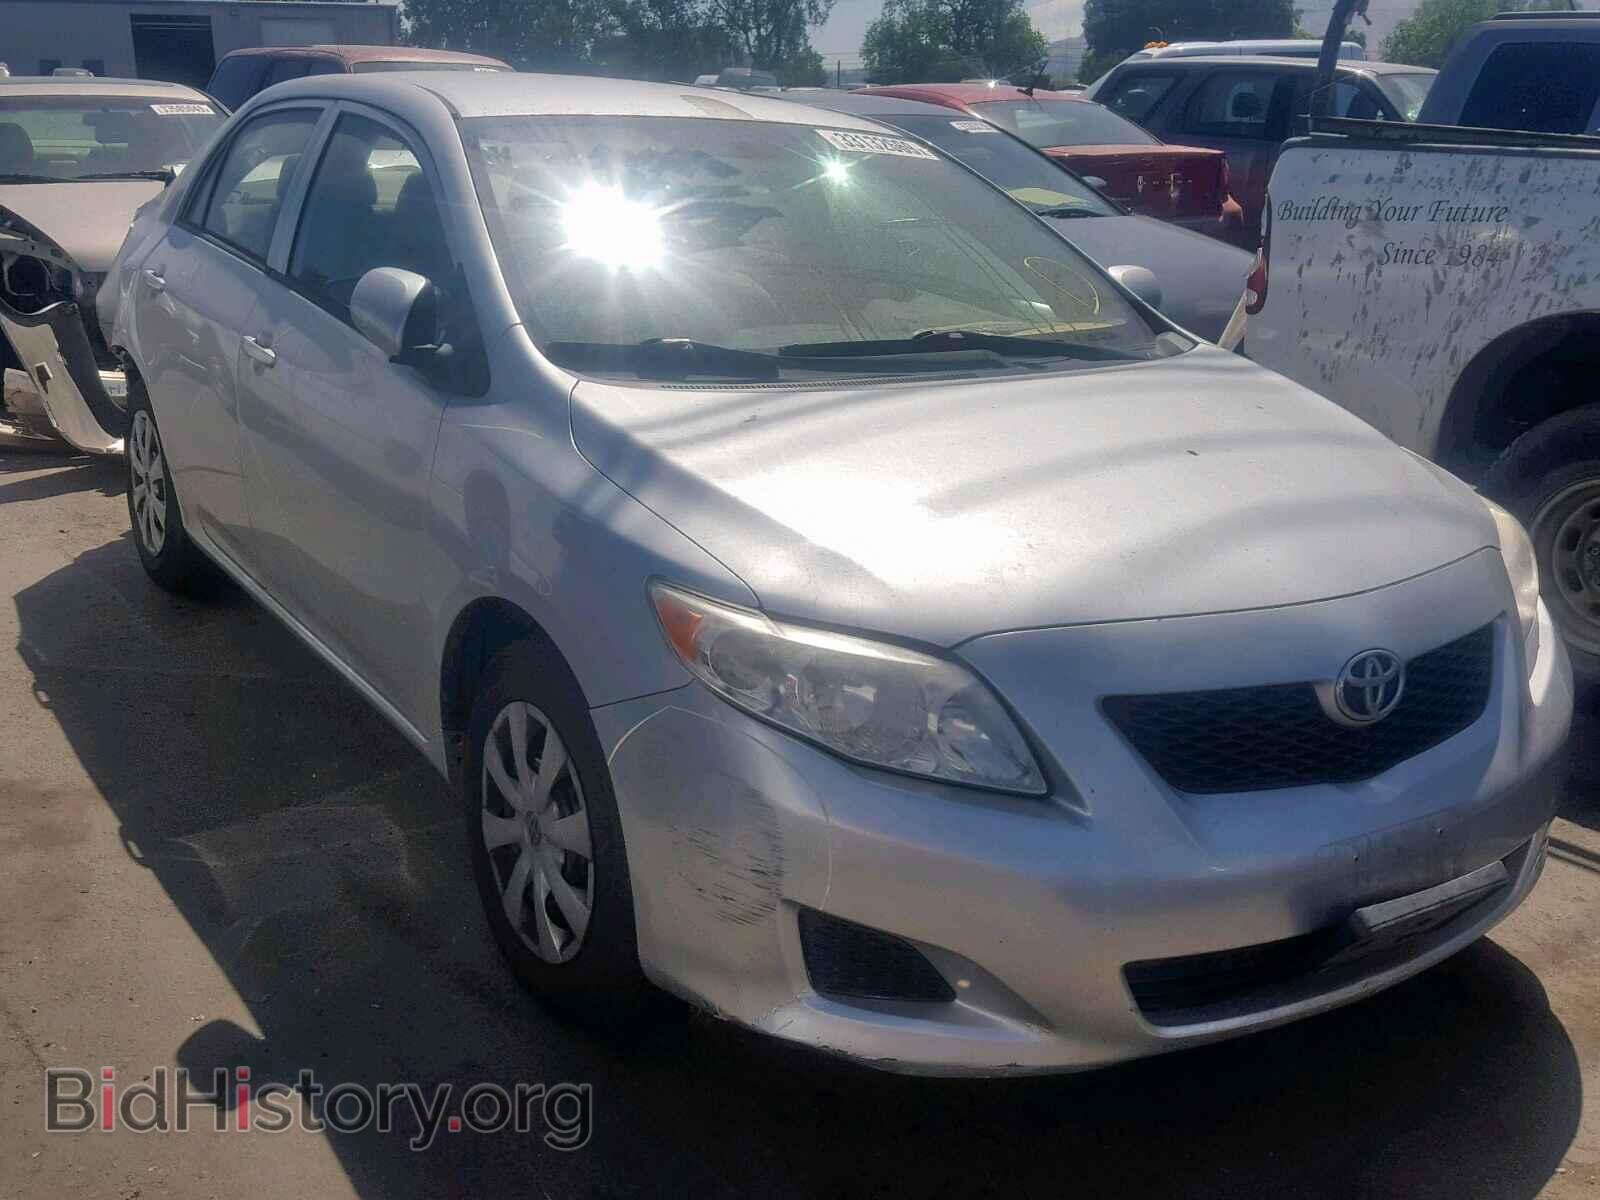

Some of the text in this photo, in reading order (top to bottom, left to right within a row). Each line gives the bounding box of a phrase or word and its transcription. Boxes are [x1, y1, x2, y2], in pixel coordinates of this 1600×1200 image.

[1278, 196, 1508, 229] Building Your Future
[1380, 241, 1503, 268] Since 1984
